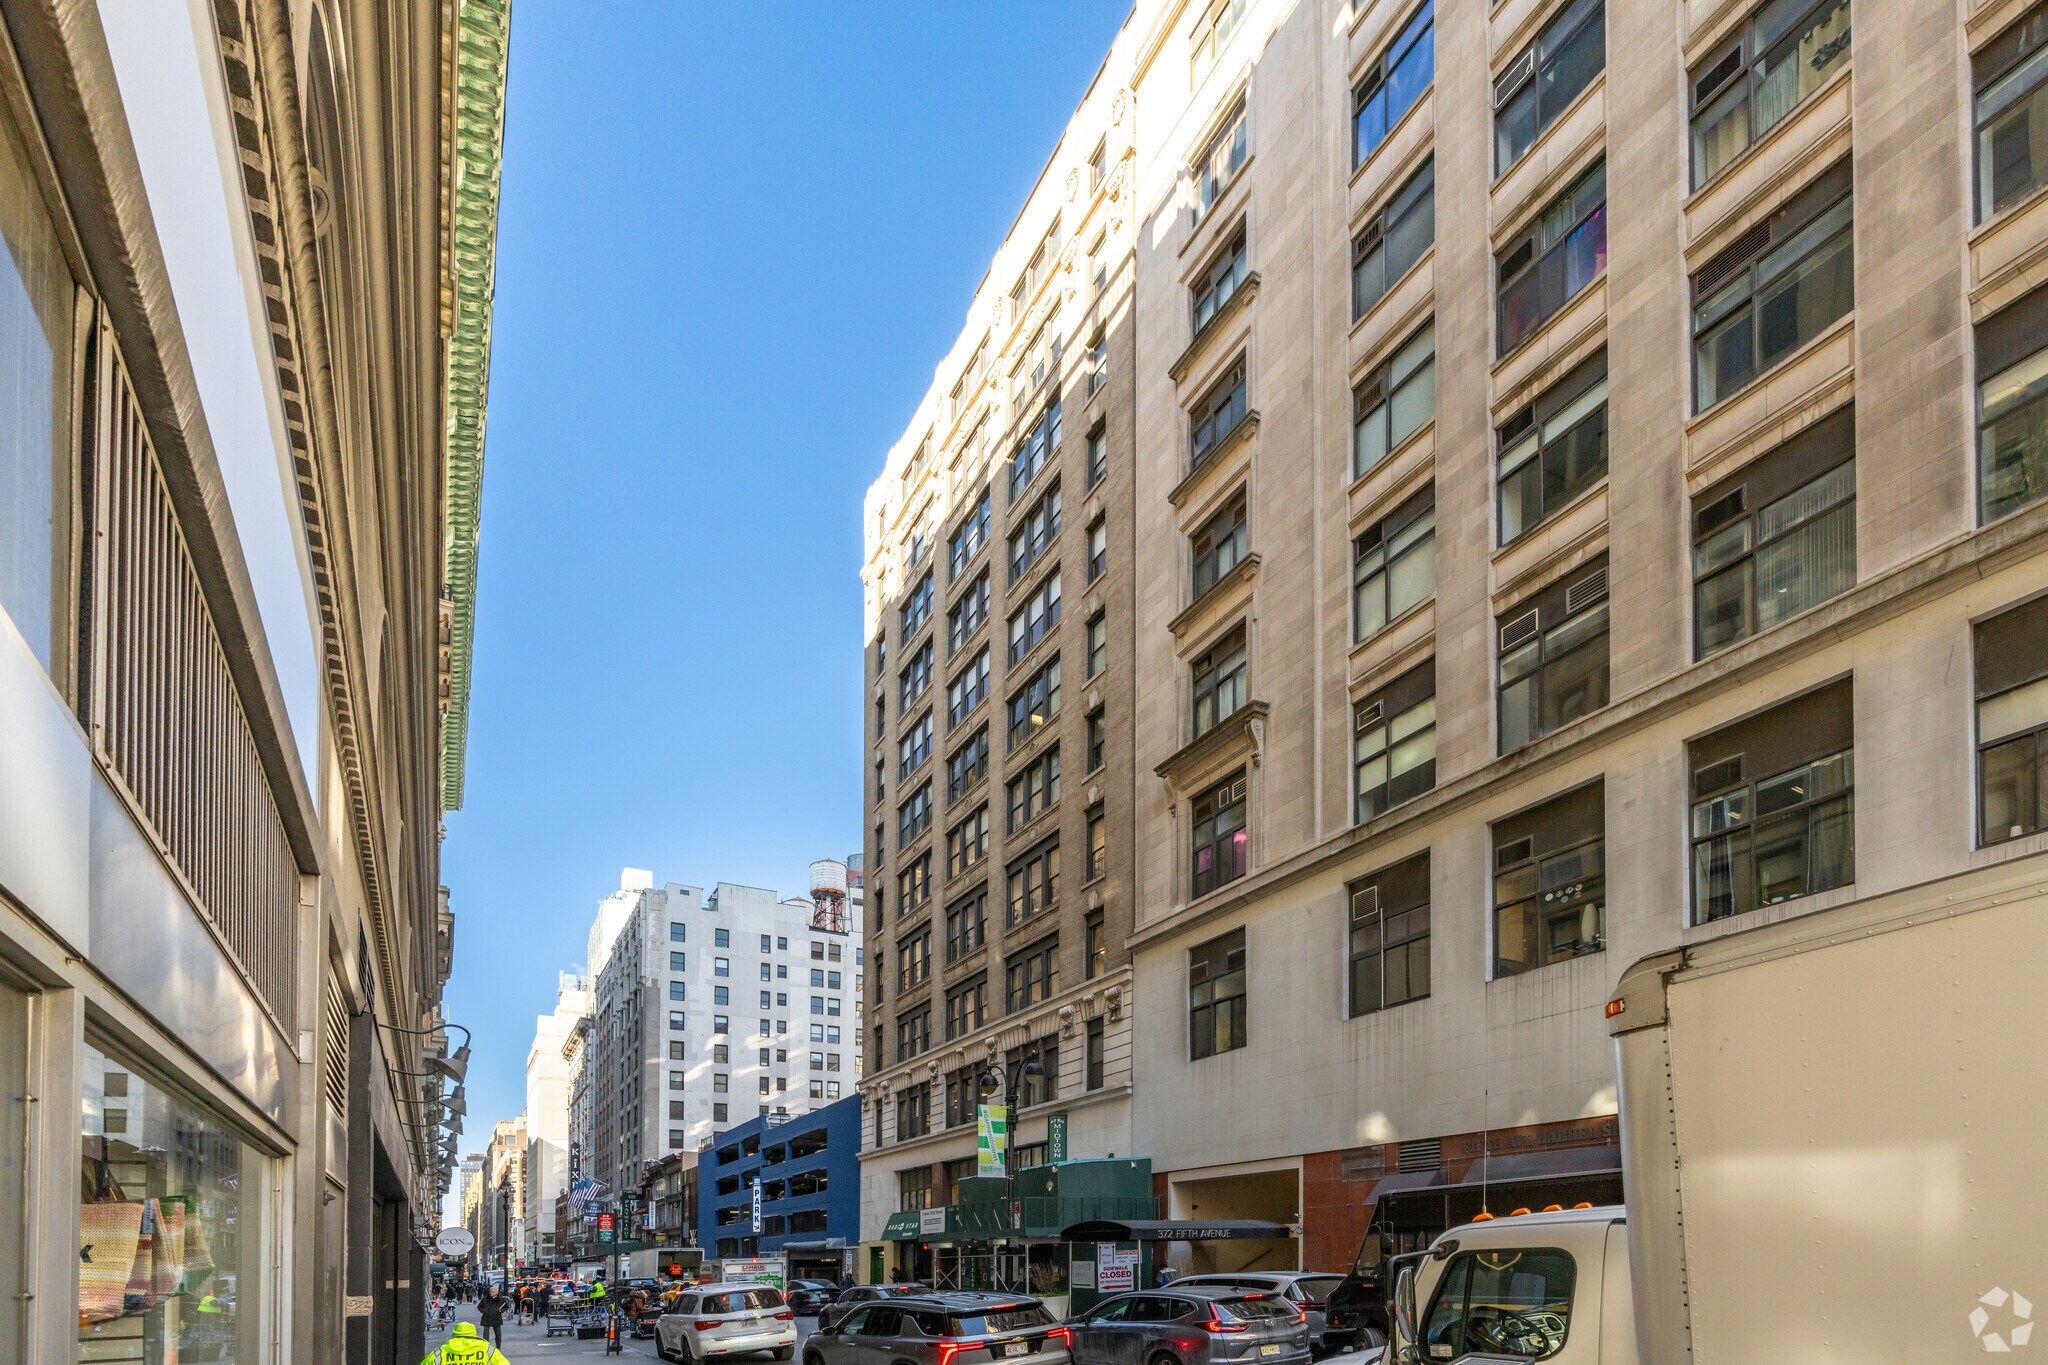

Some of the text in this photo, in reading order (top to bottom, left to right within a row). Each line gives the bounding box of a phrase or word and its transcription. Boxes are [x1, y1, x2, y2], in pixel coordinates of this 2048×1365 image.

[1053, 1123, 1062, 1158] MIDTOWN
[1157, 1229, 1231, 1239] 372 FIFTH AVENUE
[1099, 1270, 1132, 1279] CLOSED
